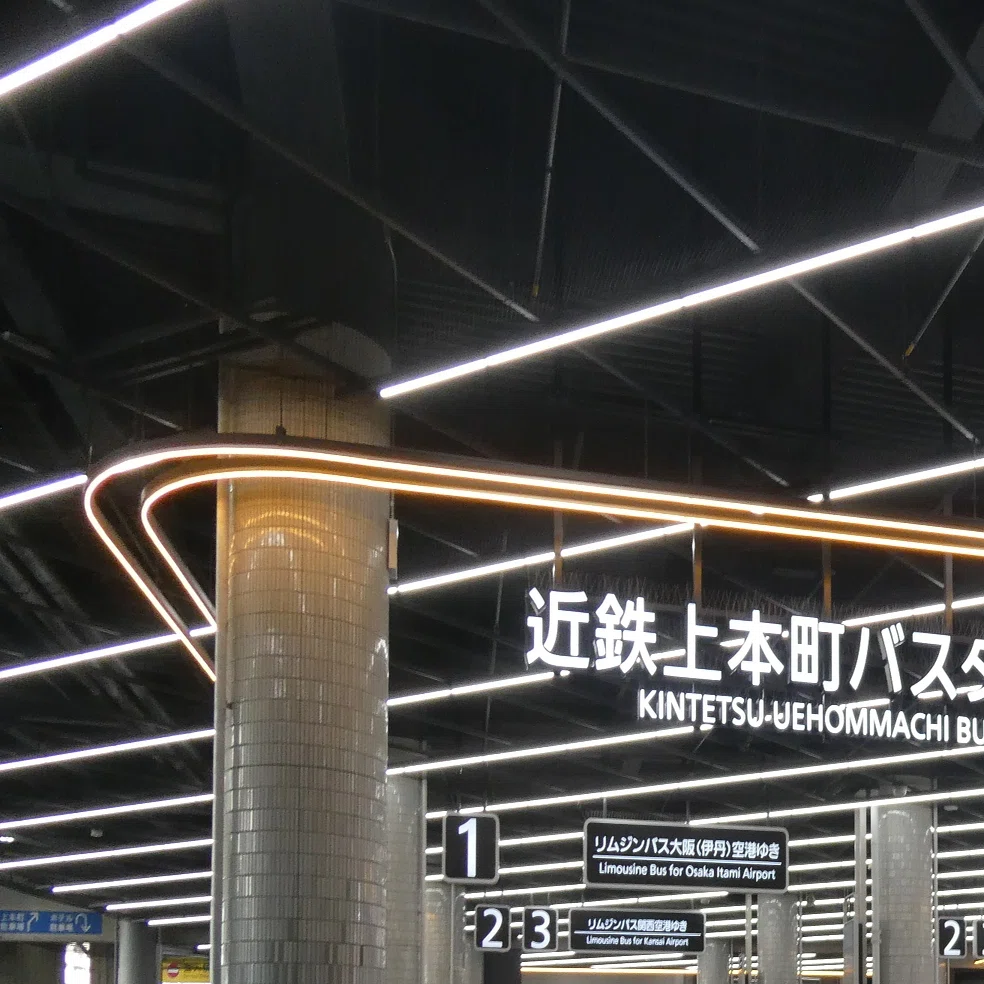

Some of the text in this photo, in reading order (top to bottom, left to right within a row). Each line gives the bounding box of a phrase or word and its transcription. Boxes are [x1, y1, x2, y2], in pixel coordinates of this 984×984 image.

[638, 688, 949, 742] KINTETSU-UEHOMMACHI
[458, 817, 477, 878] 1
[599, 862, 777, 883] Limousine Bus for Osaka Itami Airport
[481, 907, 551, 950] 2 3
[586, 935, 619, 946] Limousine
[620, 935, 632, 946] Bus
[633, 935, 643, 946] for
[666, 937, 689, 948] Airport
[943, 919, 961, 956] 2
